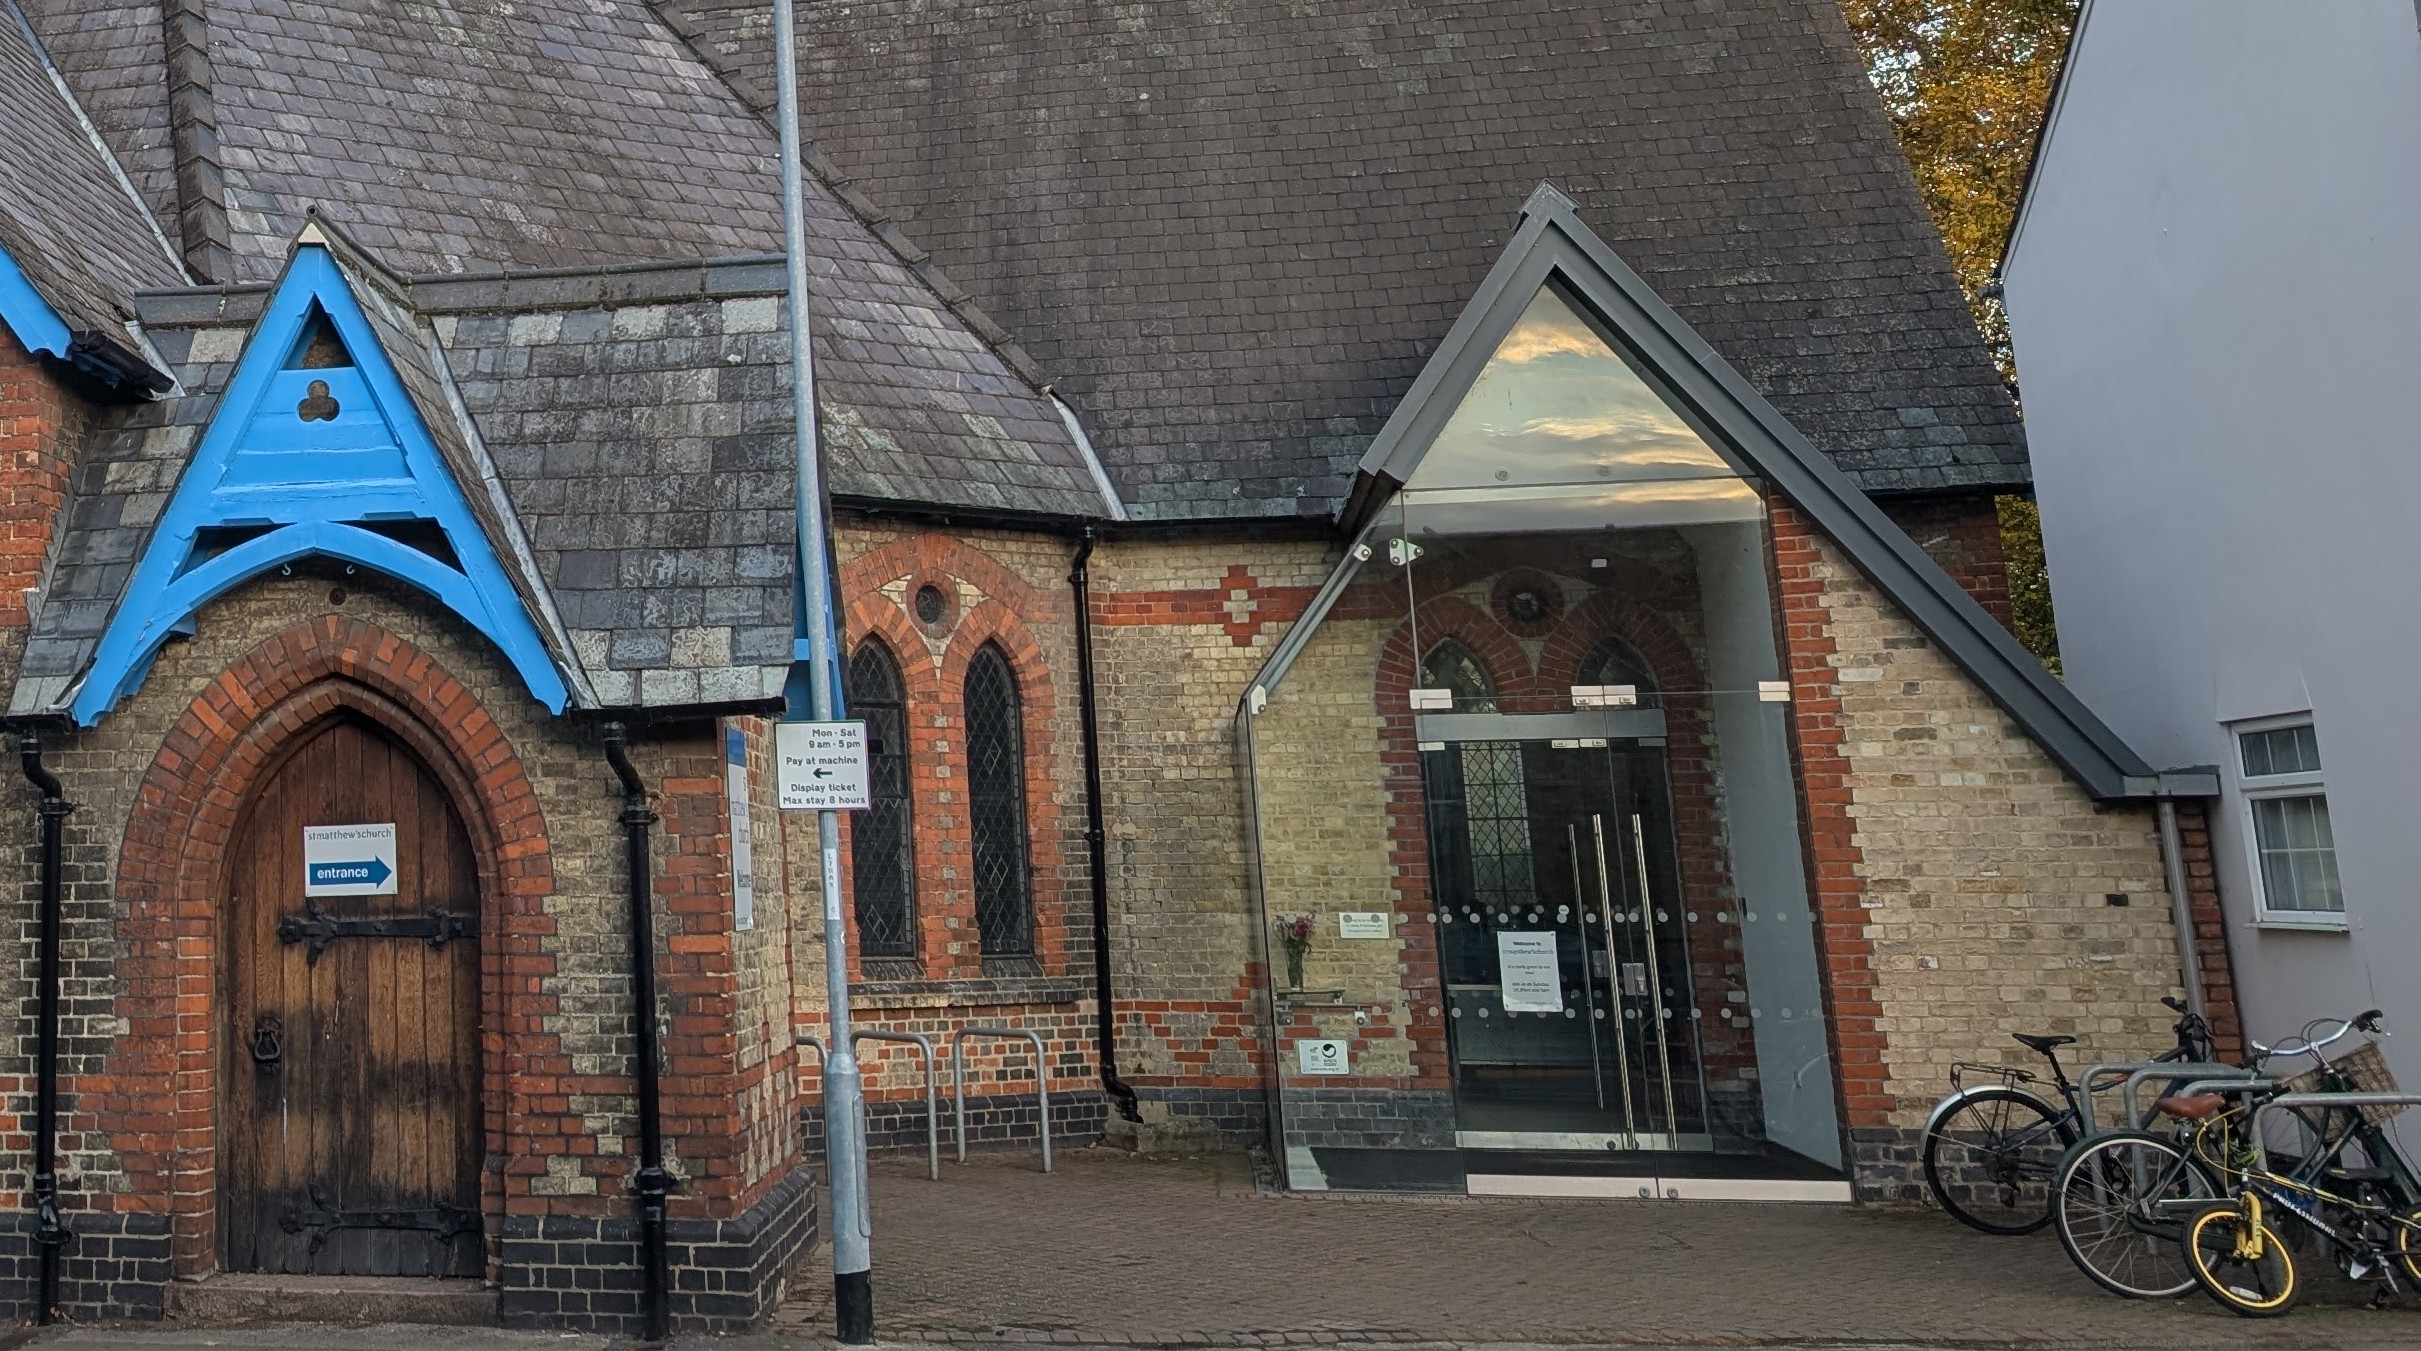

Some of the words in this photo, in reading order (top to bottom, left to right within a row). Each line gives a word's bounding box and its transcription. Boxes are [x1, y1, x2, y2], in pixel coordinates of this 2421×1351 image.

[812, 728, 833, 737] Mon
[840, 728, 857, 737] Sat
[808, 740, 815, 749] 9
[817, 741, 832, 749] am
[838, 739, 845, 749] 5
[846, 741, 861, 750] pm
[786, 756, 803, 767] Pay
[805, 756, 816, 765] at
[818, 755, 859, 765] machine
[790, 783, 826, 794] Display
[828, 783, 857, 792] ticket
[782, 796, 803, 805] Max
[805, 796, 826, 806] stay
[829, 795, 836, 804] 8
[838, 795, 866, 804] hours
[316, 867, 369, 879] entrance
